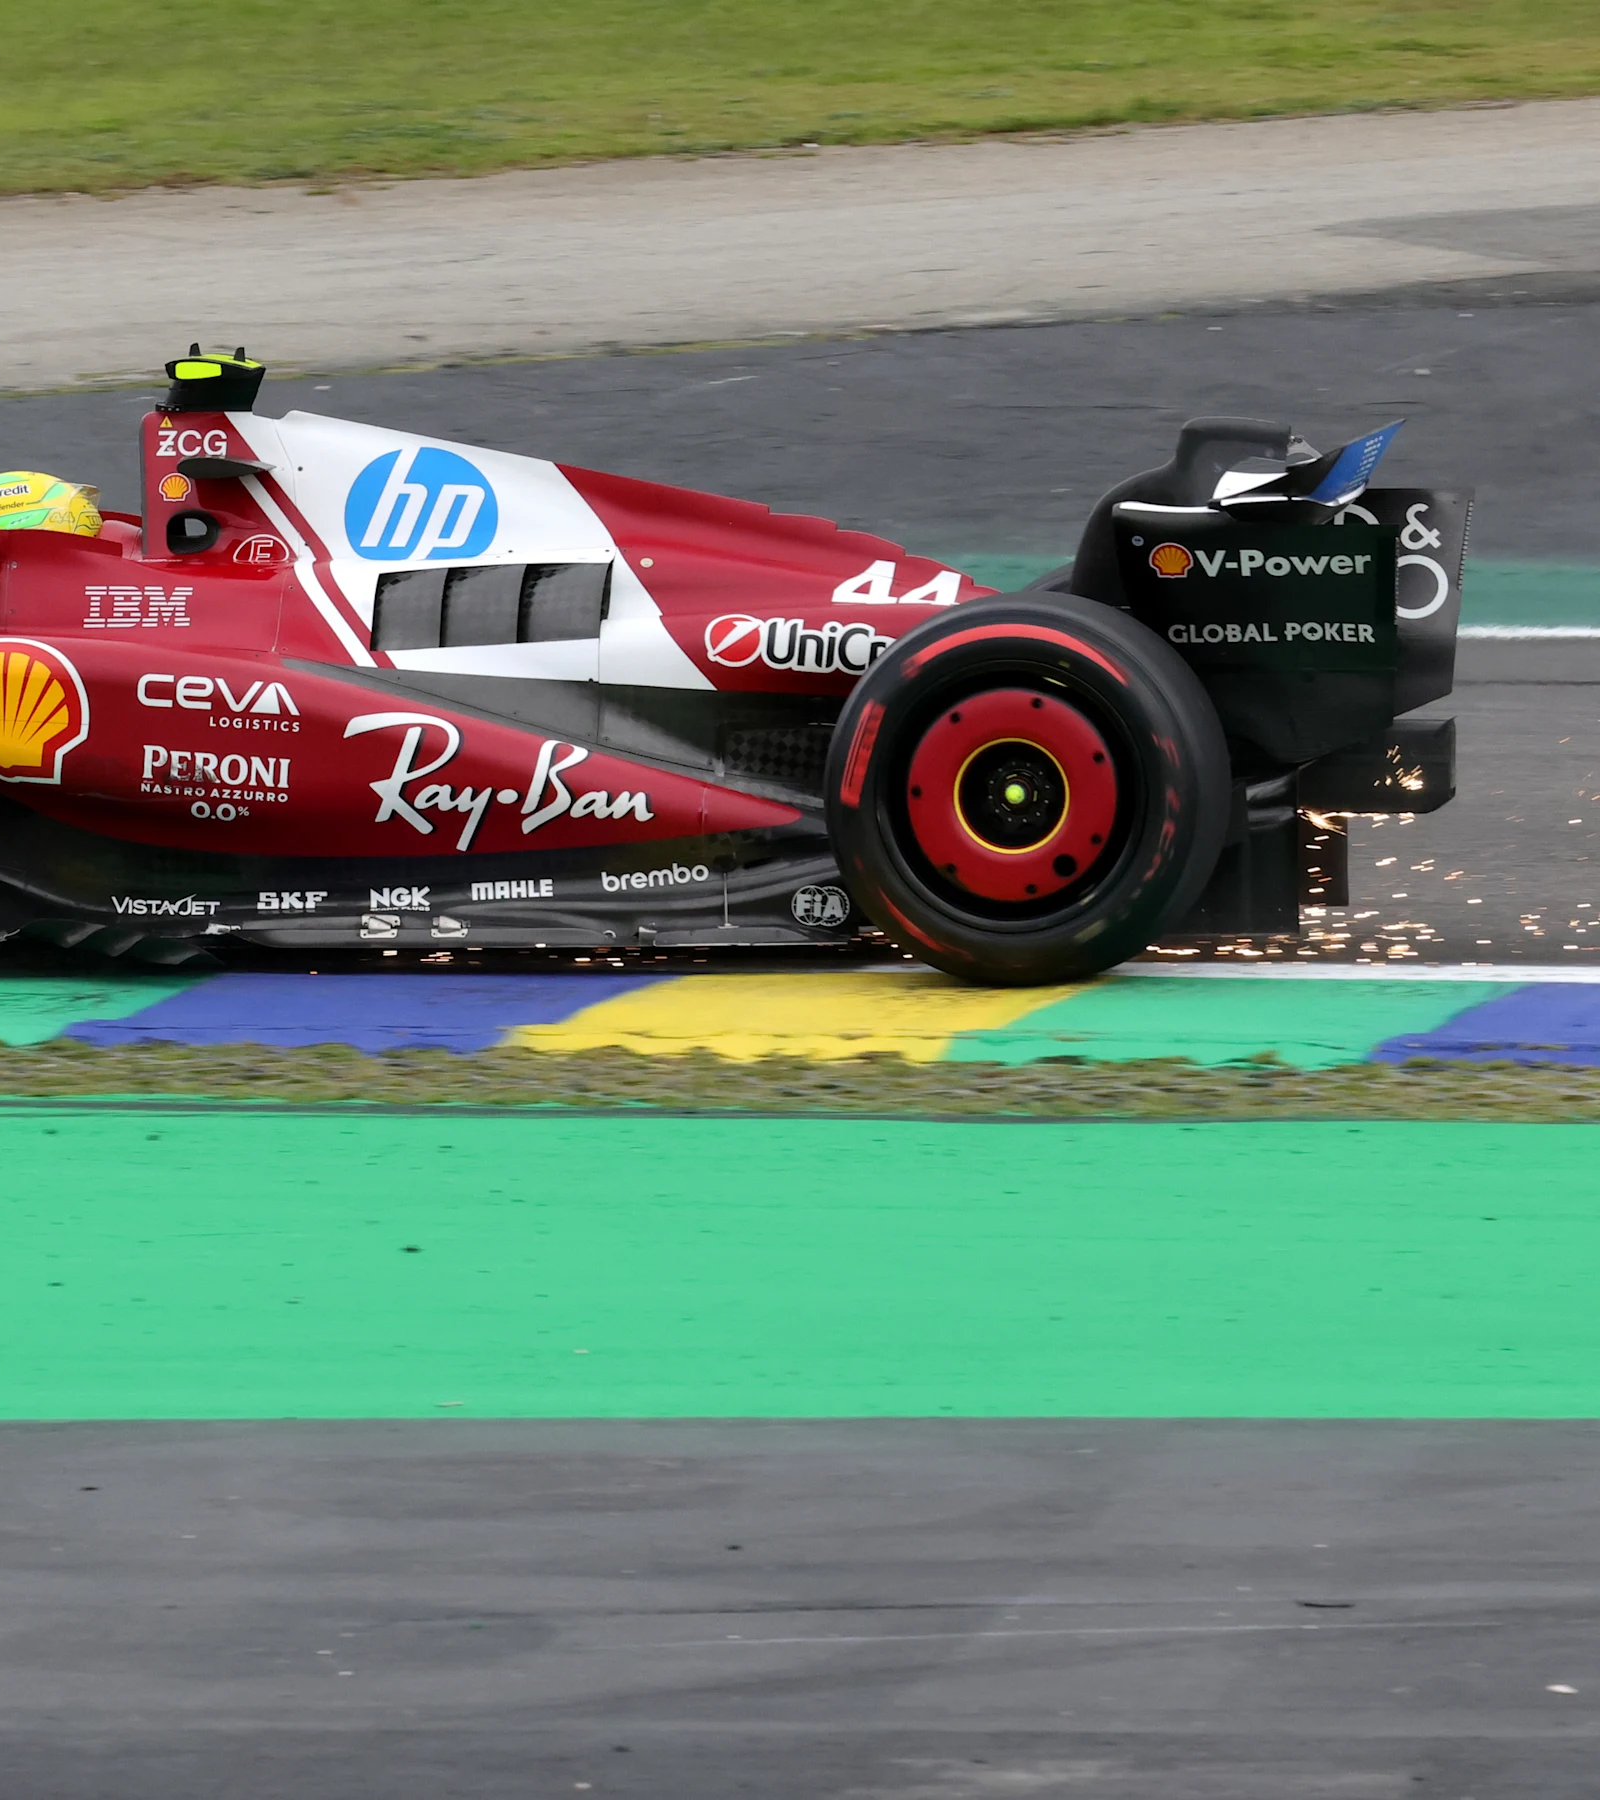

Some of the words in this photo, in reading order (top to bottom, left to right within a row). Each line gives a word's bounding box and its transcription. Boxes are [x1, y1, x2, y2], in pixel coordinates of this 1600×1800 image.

[359, 446, 486, 560] hp
[1194, 549, 1372, 578] V-Power
[831, 559, 962, 606] 44
[83, 585, 194, 629] IBM
[1167, 622, 1279, 644] GLOBAL
[1283, 621, 1376, 644] POKER
[209, 716, 301, 733] LOGISTICS
[141, 744, 291, 789] PERONI
[140, 782, 206, 797] NASTRO
[210, 788, 289, 803] AZZURRO
[471, 878, 554, 901] MAHLE
[601, 862, 710, 893] brembo
[256, 890, 328, 911] SKF
[369, 885, 431, 908] NGK
